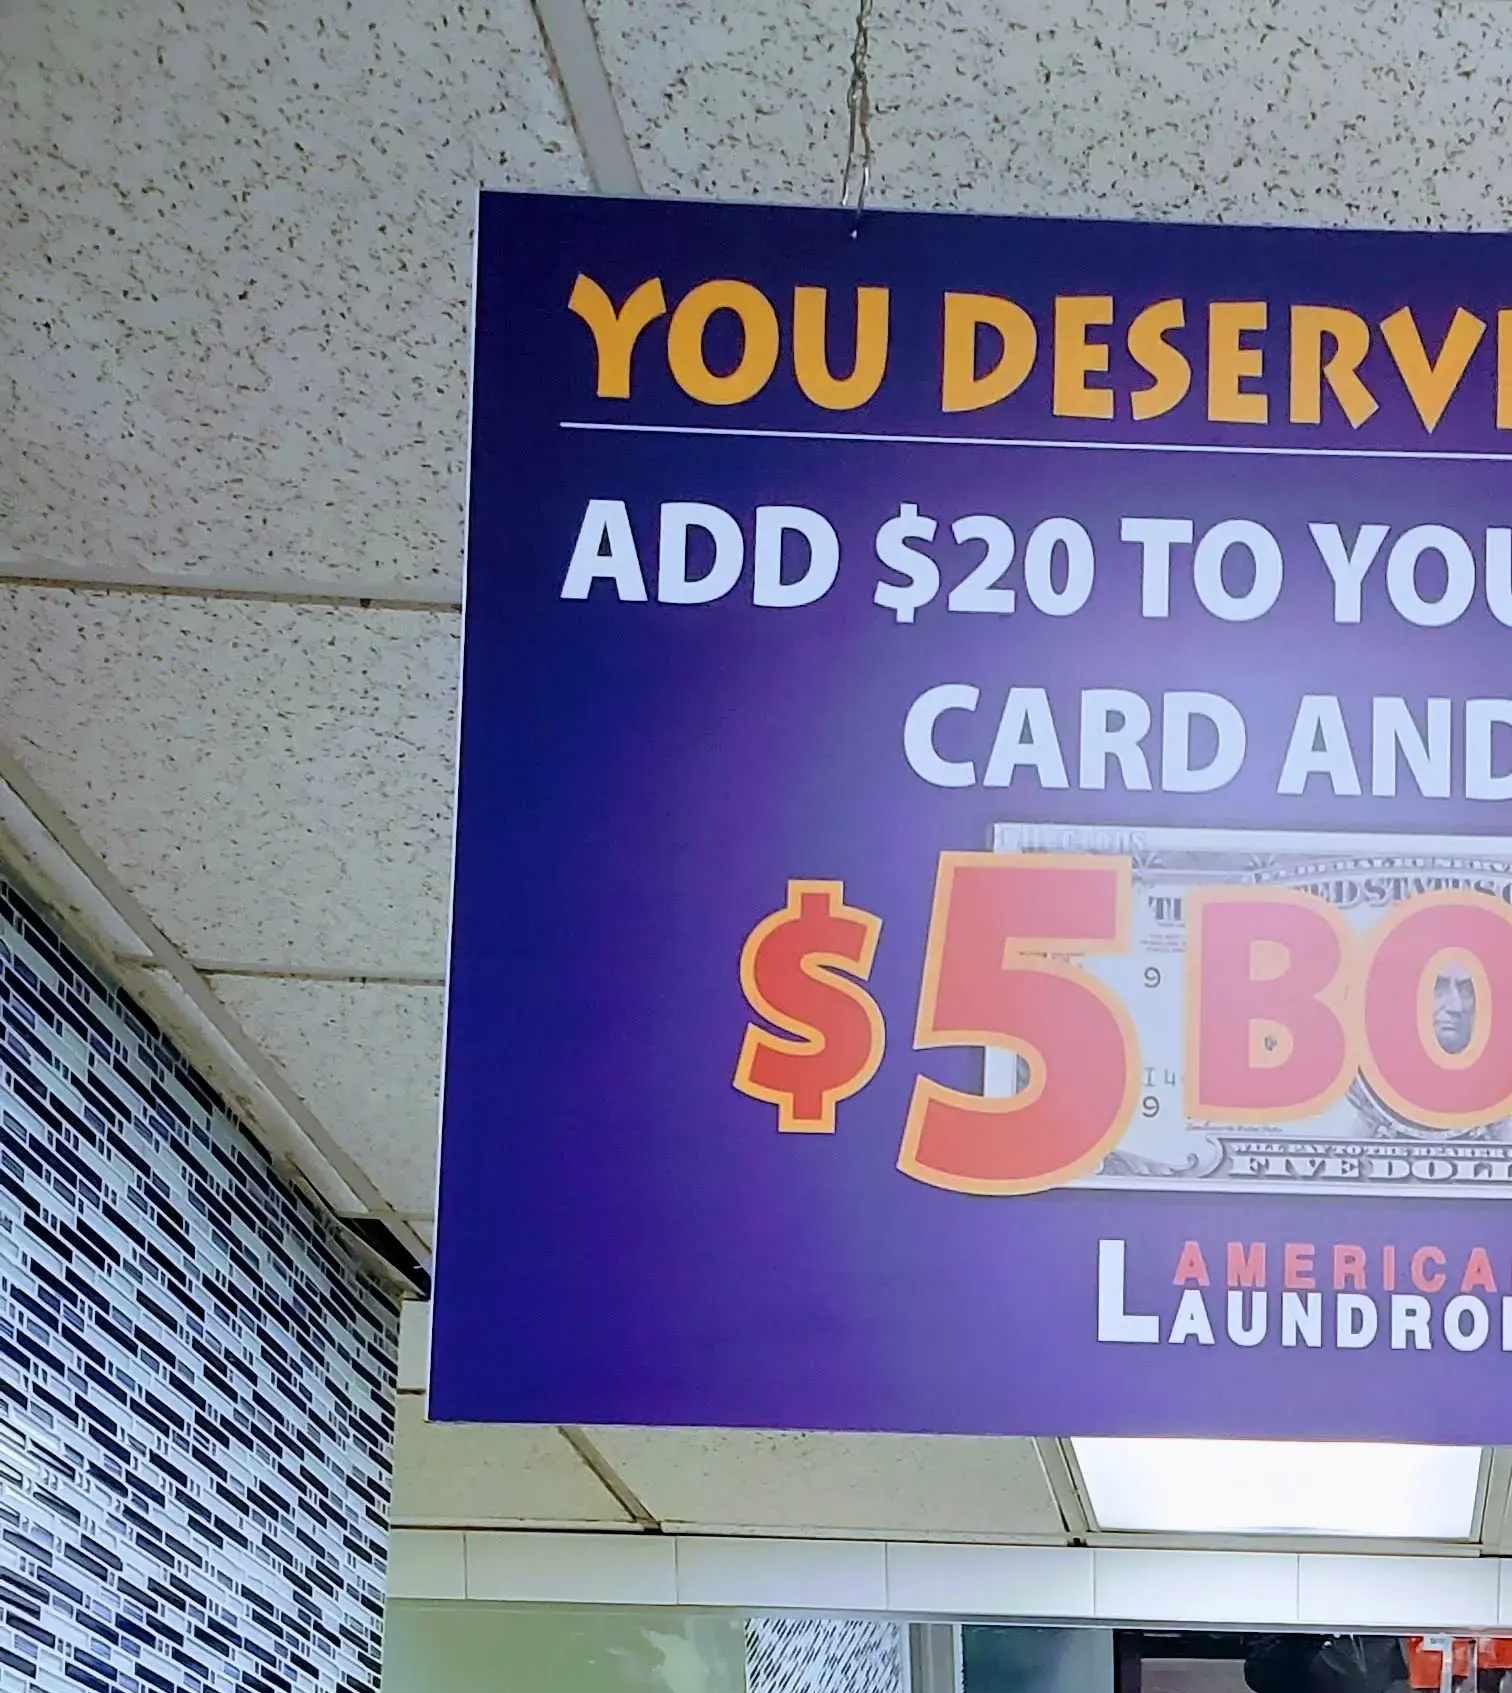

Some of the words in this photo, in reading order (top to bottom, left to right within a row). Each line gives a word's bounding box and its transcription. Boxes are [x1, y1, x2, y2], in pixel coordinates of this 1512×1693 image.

[569, 271, 890, 410] YOU
[560, 498, 840, 608] ADD
[873, 503, 1095, 623] $20
[1120, 516, 1284, 622] TO
[903, 683, 1247, 792] CARD
[732, 851, 1141, 1196] $5
